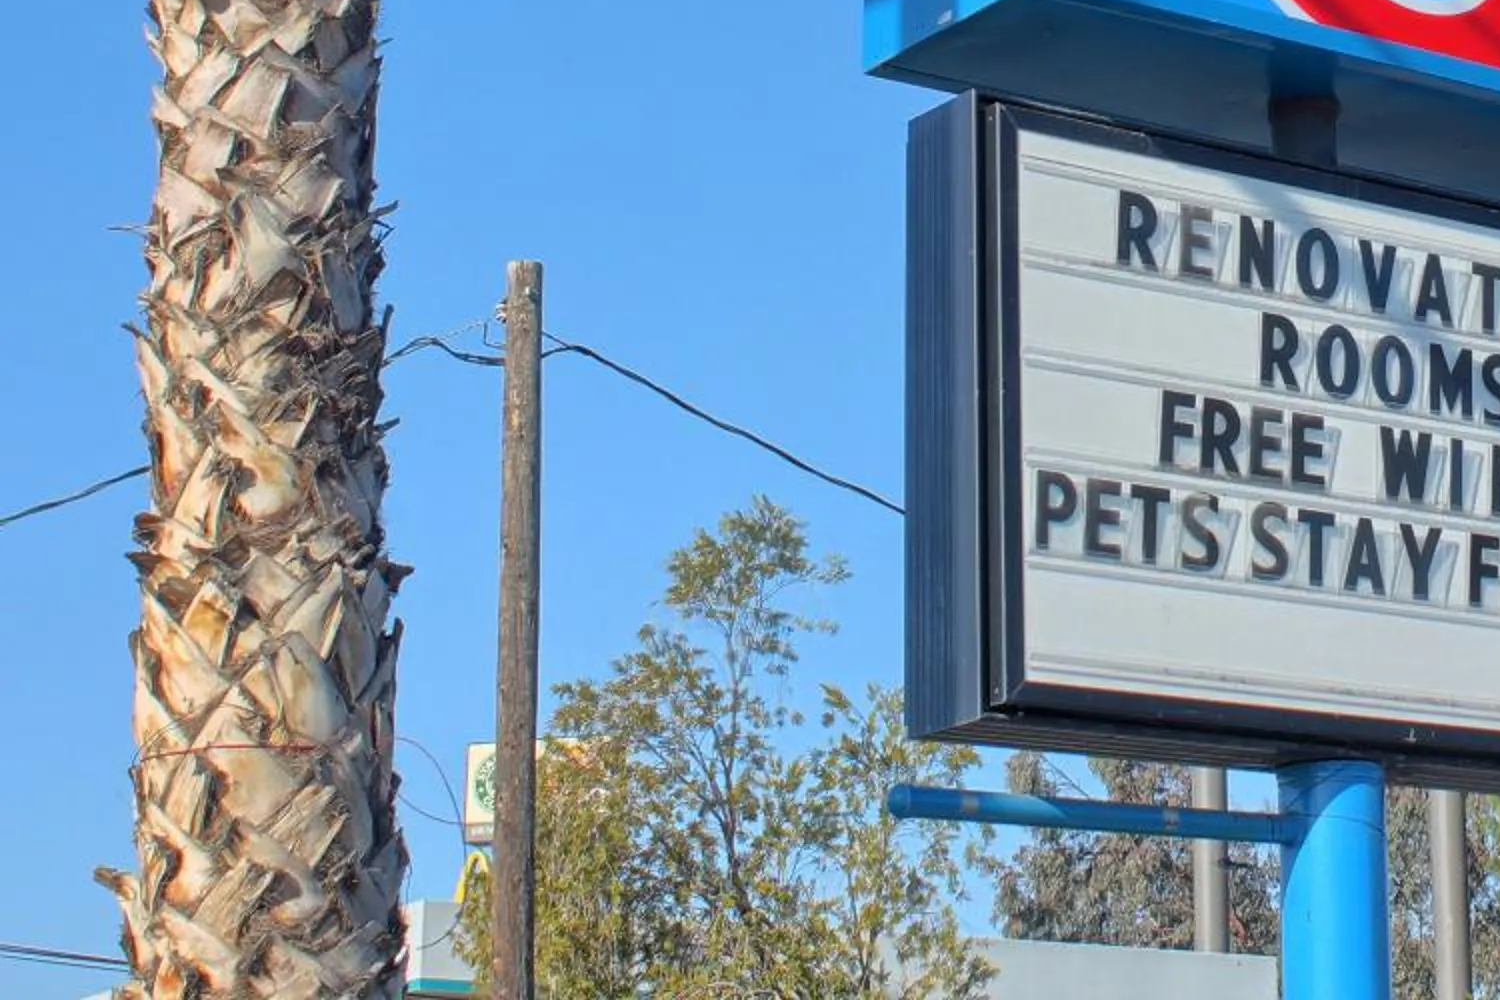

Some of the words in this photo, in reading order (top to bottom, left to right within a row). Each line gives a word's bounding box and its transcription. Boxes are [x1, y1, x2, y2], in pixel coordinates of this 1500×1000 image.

[1159, 389, 1328, 487] FREE
[1035, 469, 1220, 570] PETS
[1249, 501, 1443, 602] STAY
